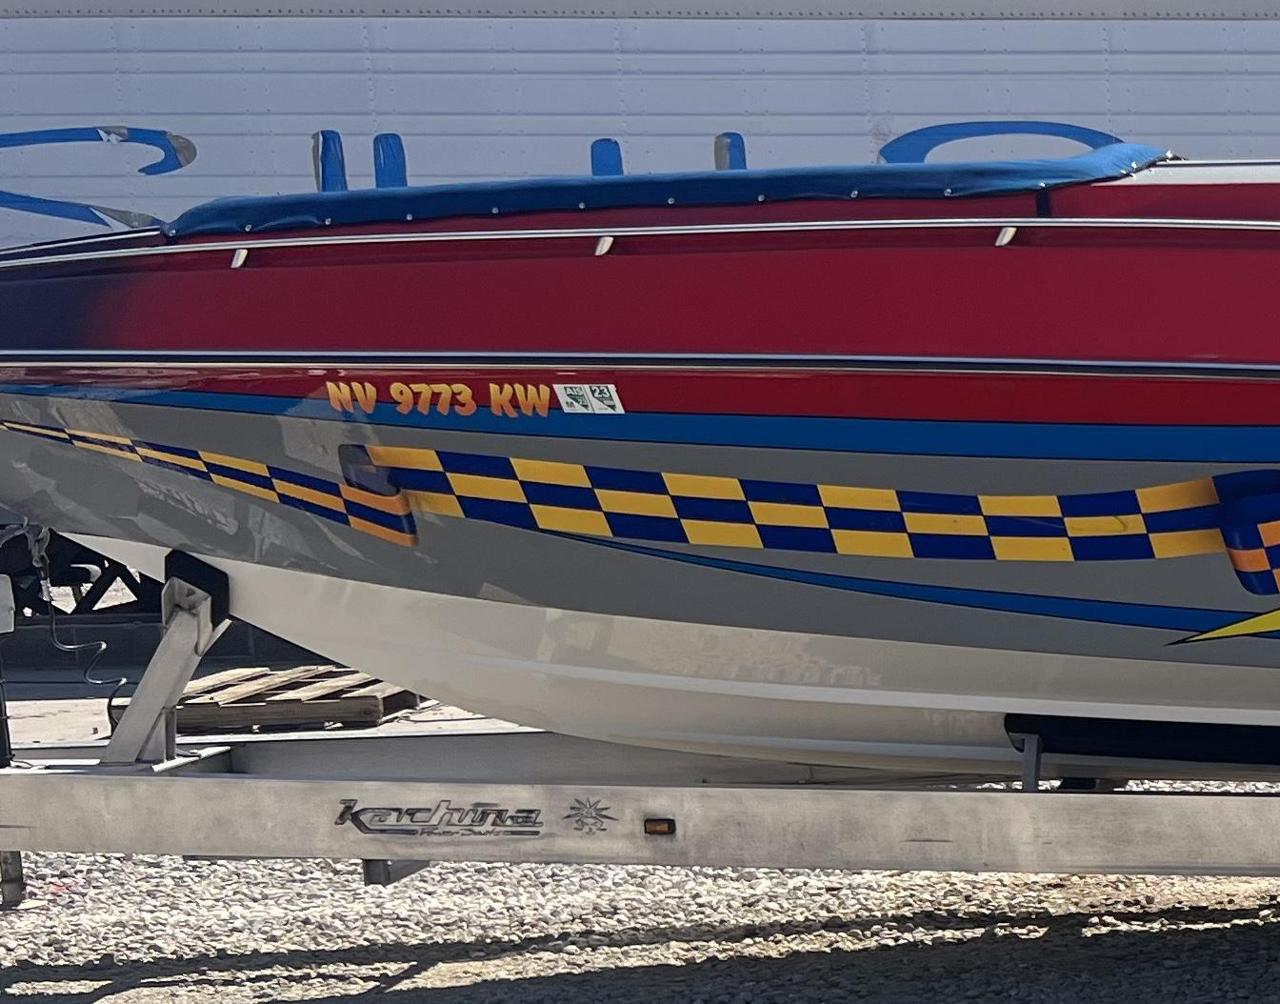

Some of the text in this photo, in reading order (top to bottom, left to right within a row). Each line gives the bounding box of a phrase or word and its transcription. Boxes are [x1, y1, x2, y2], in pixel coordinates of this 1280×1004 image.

[326, 381, 550, 417] NV 9773 KW
[592, 386, 610, 398] 23
